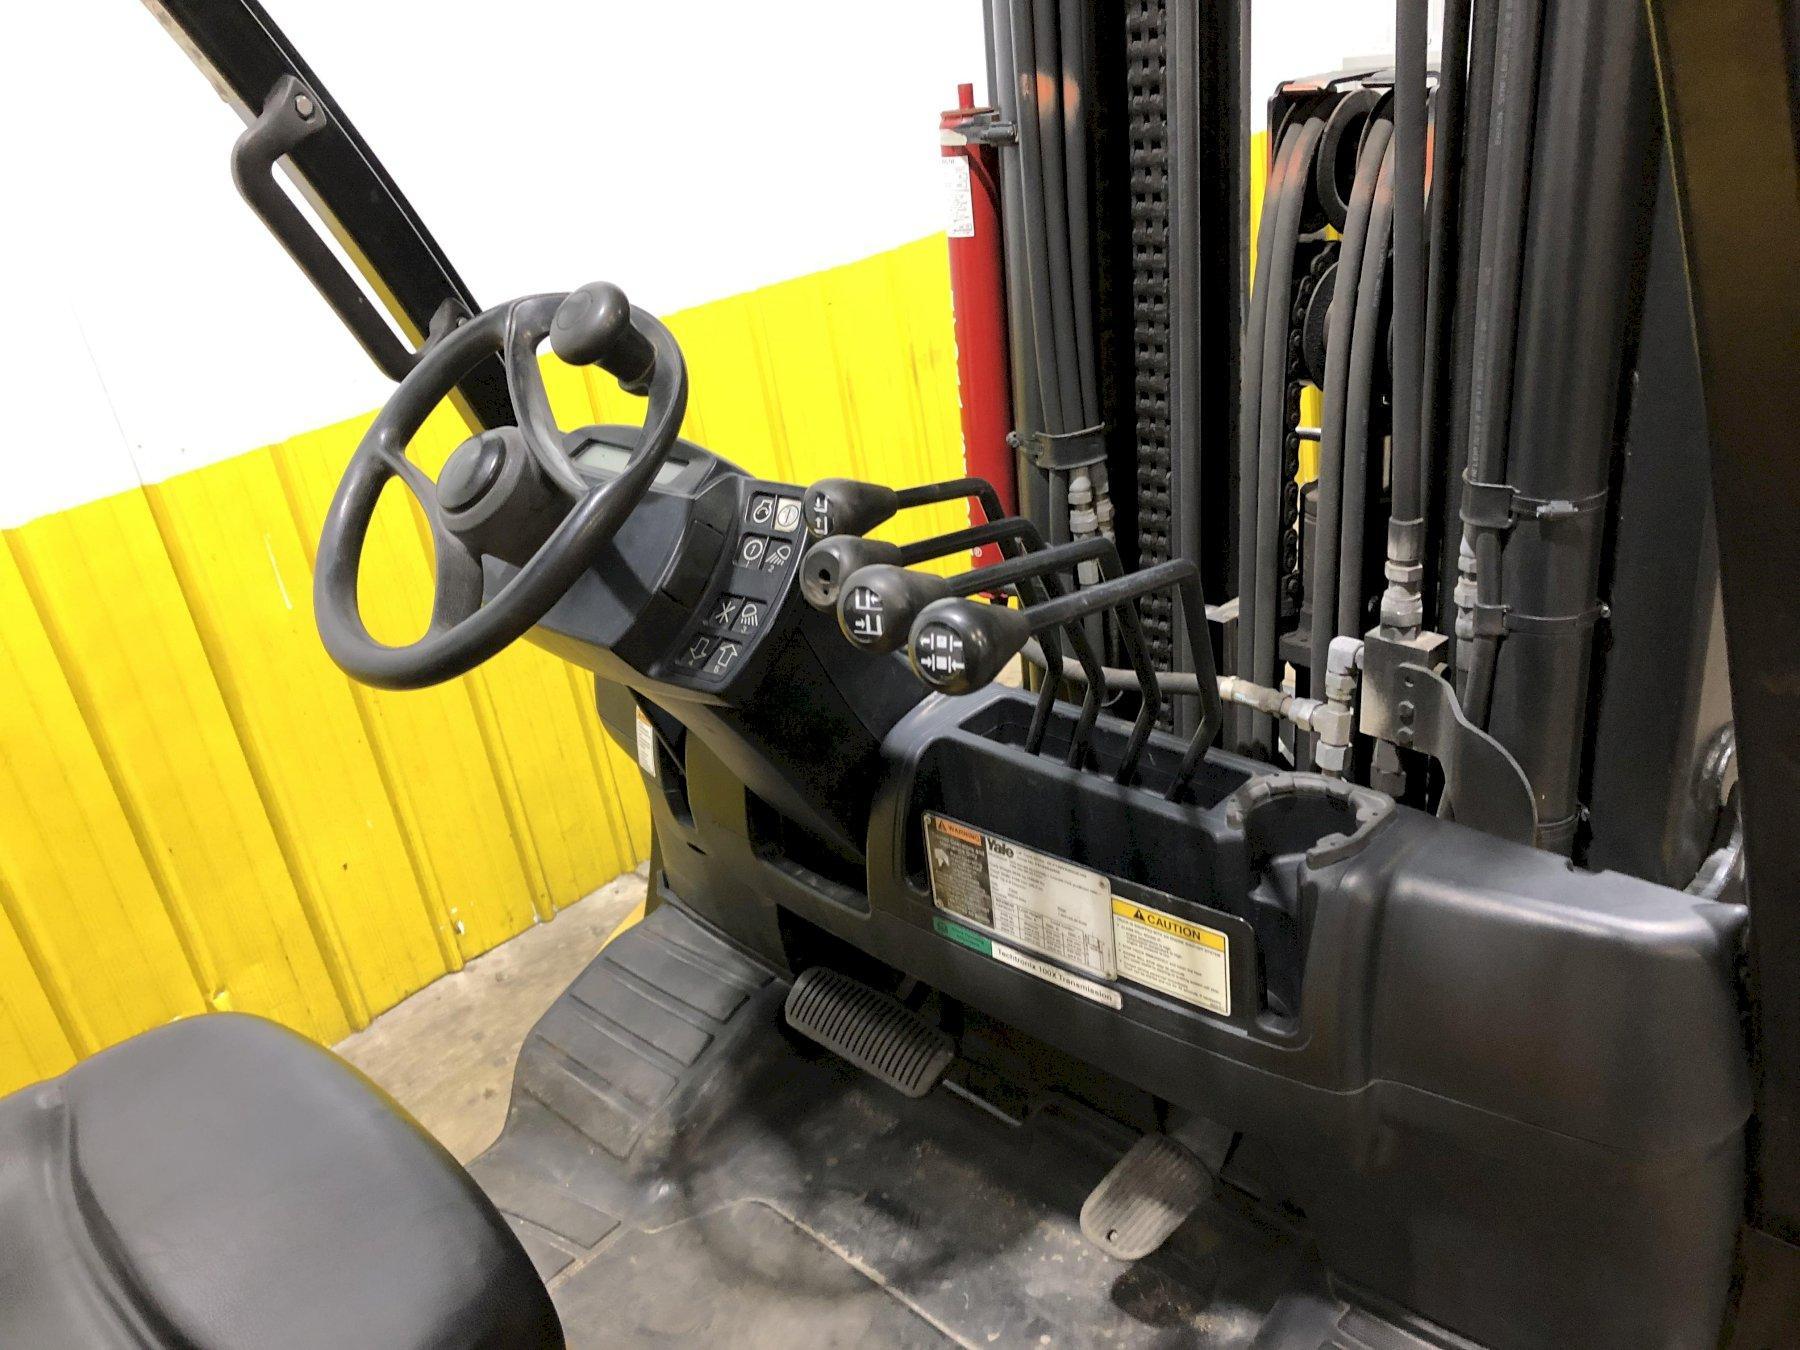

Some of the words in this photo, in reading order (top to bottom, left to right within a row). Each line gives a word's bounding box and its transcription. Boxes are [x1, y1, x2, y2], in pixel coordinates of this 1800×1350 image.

[988, 836, 1014, 859] Yale
[1147, 913, 1201, 941] CAUTION
[1038, 965, 1059, 980] 100X
[1058, 973, 1113, 1001] Transmission
